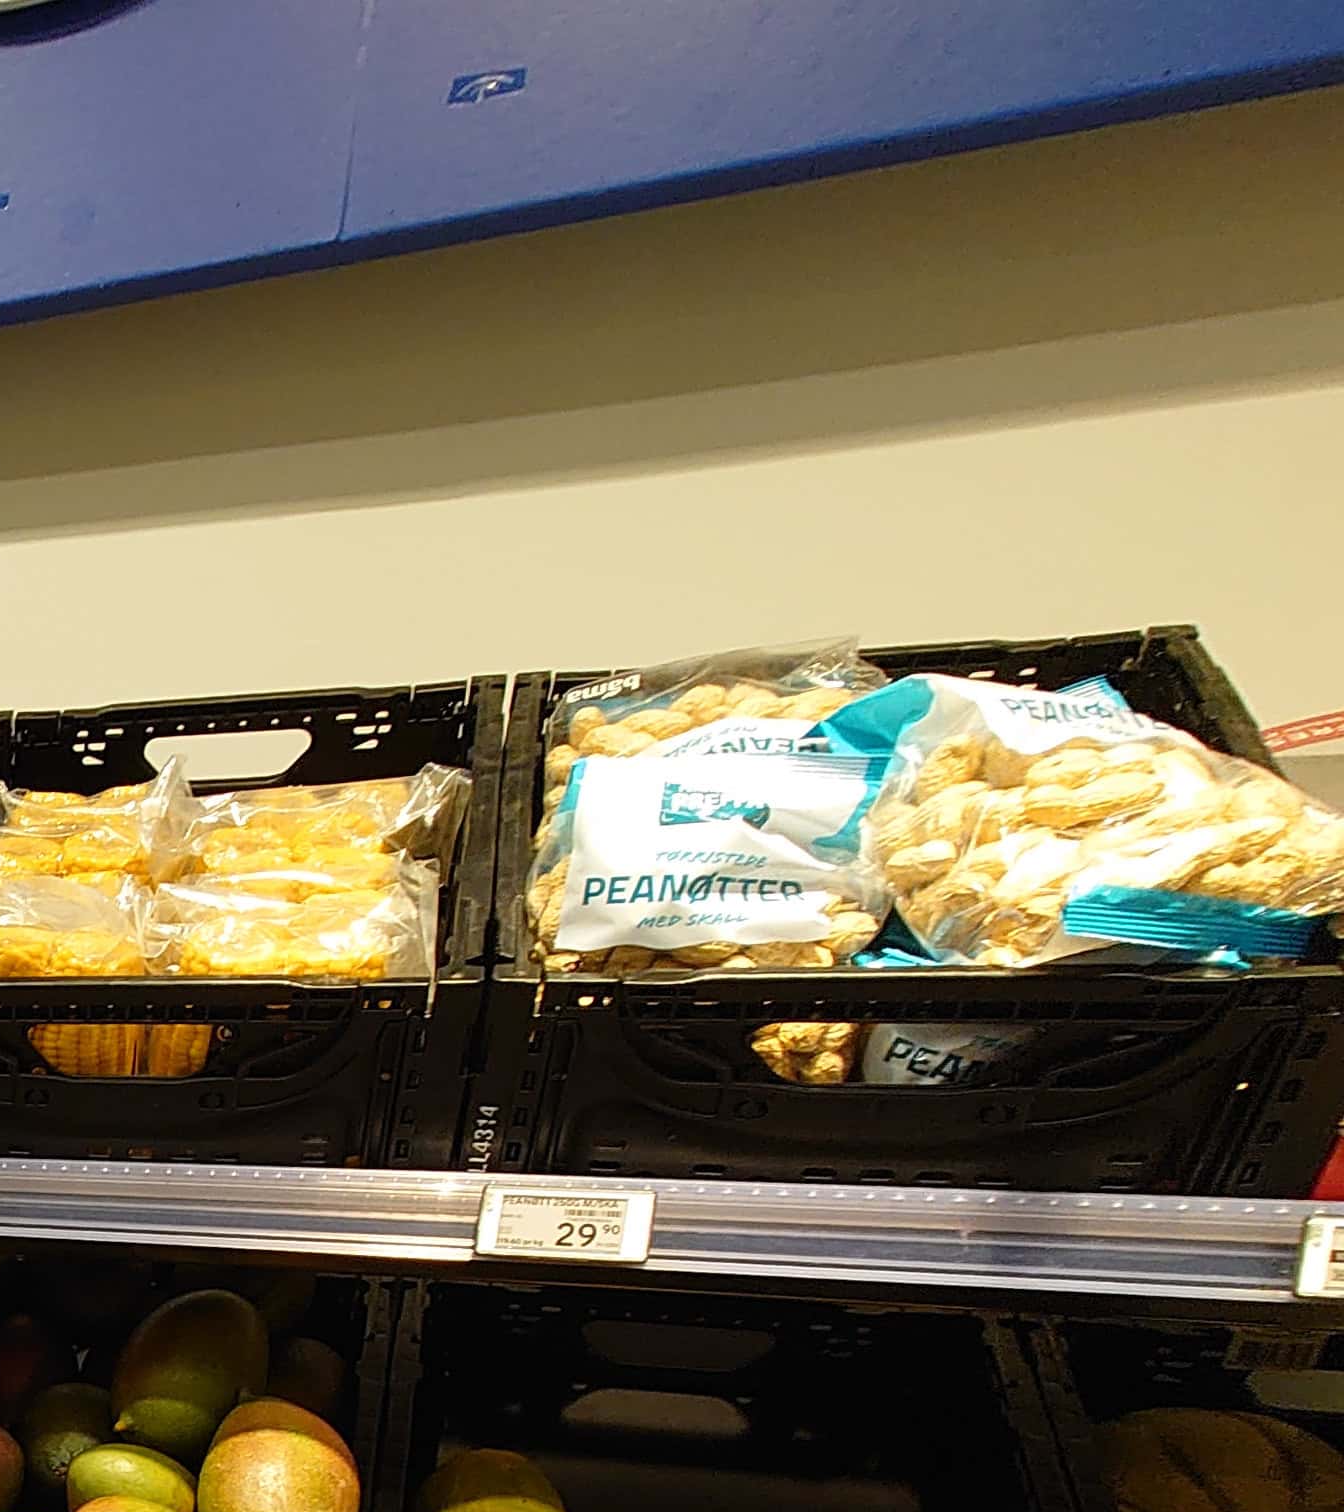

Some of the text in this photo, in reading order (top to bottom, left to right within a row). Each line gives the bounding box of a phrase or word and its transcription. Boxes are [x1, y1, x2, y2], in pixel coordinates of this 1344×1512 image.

[582, 872, 806, 905] PEANØTTER
[637, 914, 750, 928] MED SKALL
[468, 1105, 501, 1173] LL4314
[555, 1222, 620, 1247] 29 90
